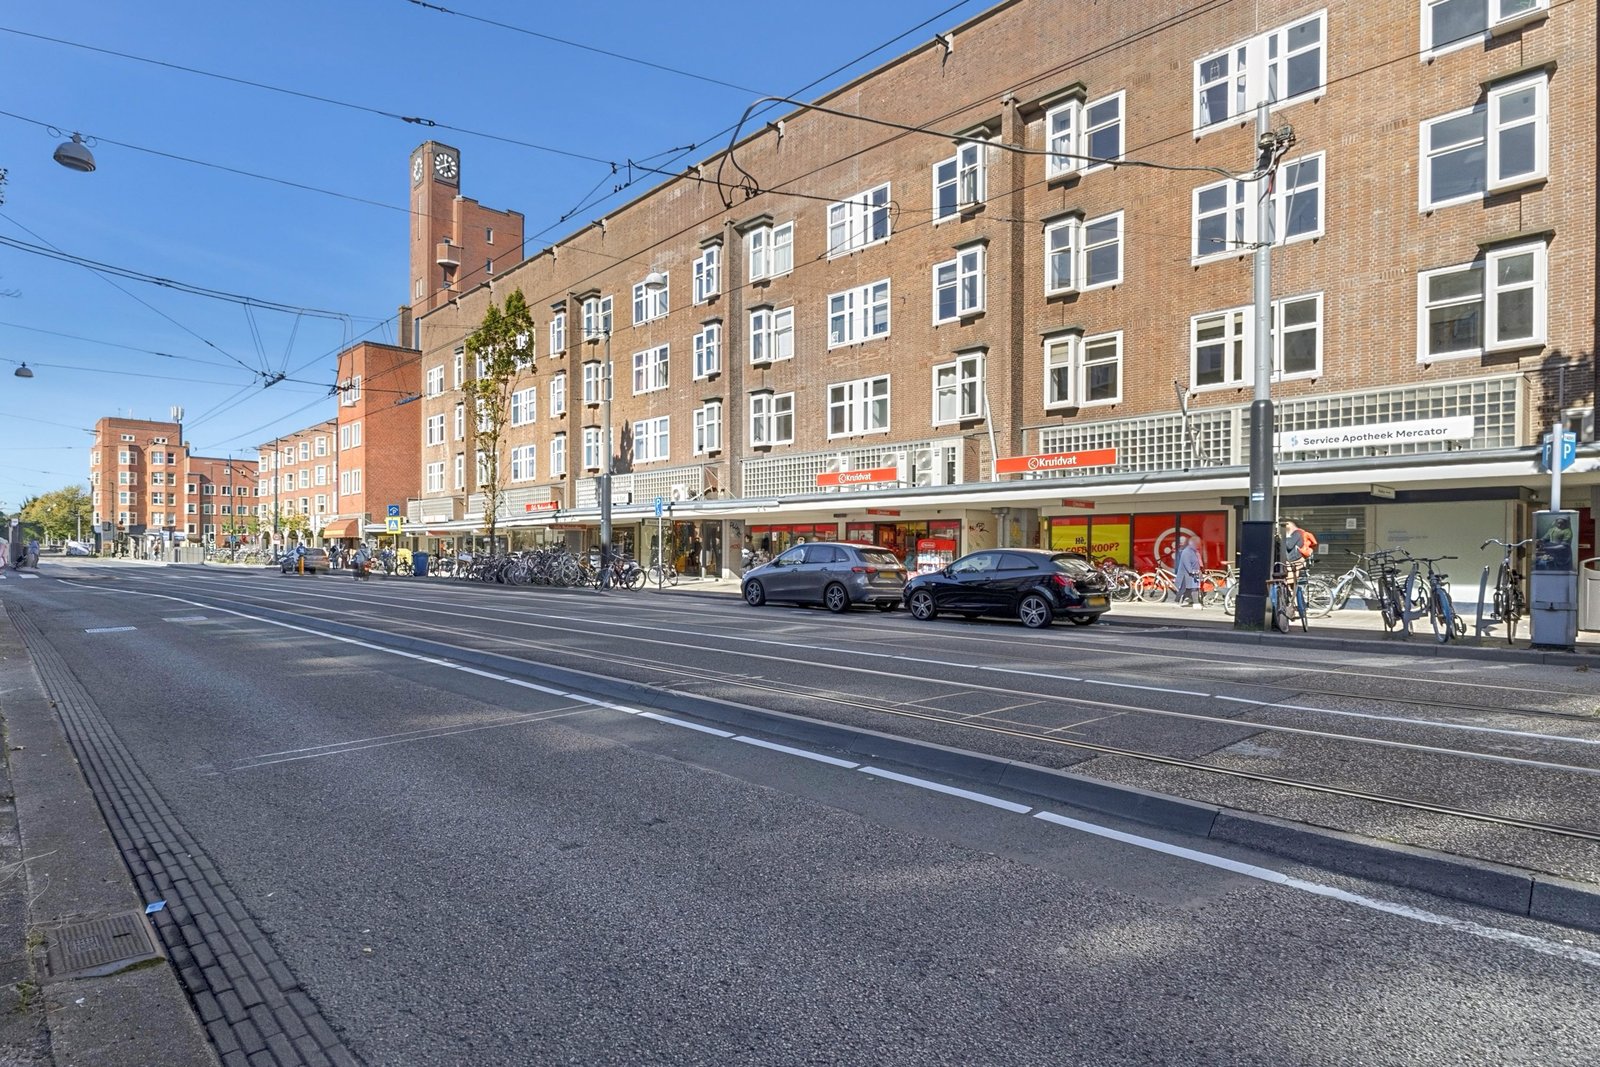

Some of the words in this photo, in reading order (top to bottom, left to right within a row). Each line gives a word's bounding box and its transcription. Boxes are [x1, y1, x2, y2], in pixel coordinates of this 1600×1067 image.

[1303, 434, 1340, 446] Service
[1342, 430, 1393, 443] Apotheek
[1396, 427, 1448, 438] Mercator
[1564, 444, 1572, 460] P
[1039, 455, 1077, 468] Kruidvat
[846, 472, 872, 482] Kruidvat
